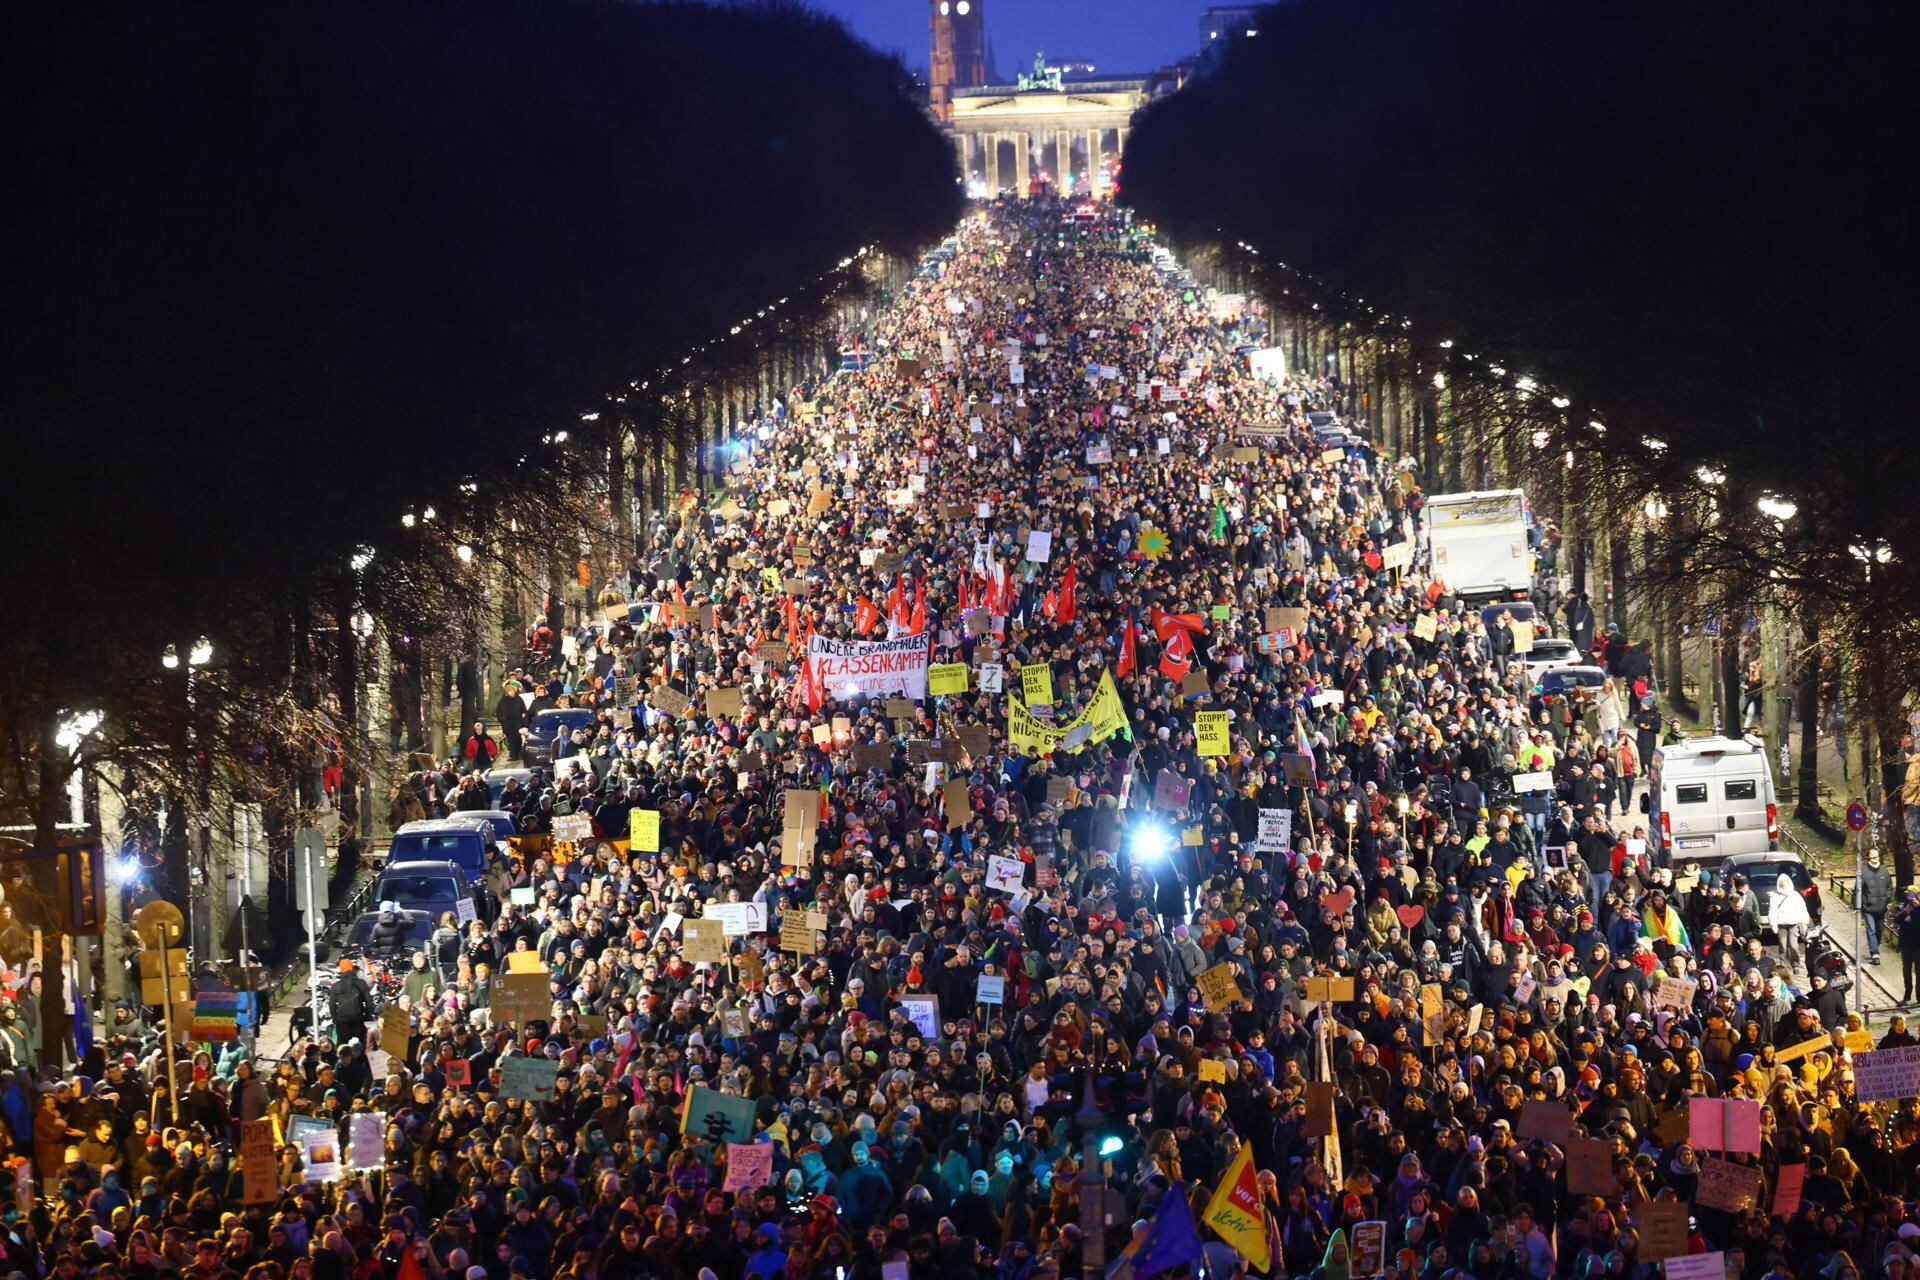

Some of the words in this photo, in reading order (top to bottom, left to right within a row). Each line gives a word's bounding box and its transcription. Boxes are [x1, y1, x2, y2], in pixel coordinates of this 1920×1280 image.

[811, 637, 855, 656] UNSERE
[859, 633, 928, 655] BRANDMAUER
[817, 652, 927, 675] KLASSENKAMPF
[1023, 665, 1048, 677] STOPPT
[1198, 714, 1226, 723] STOPPT
[1199, 724, 1214, 732] DEN
[1200, 970, 1217, 985] FCK
